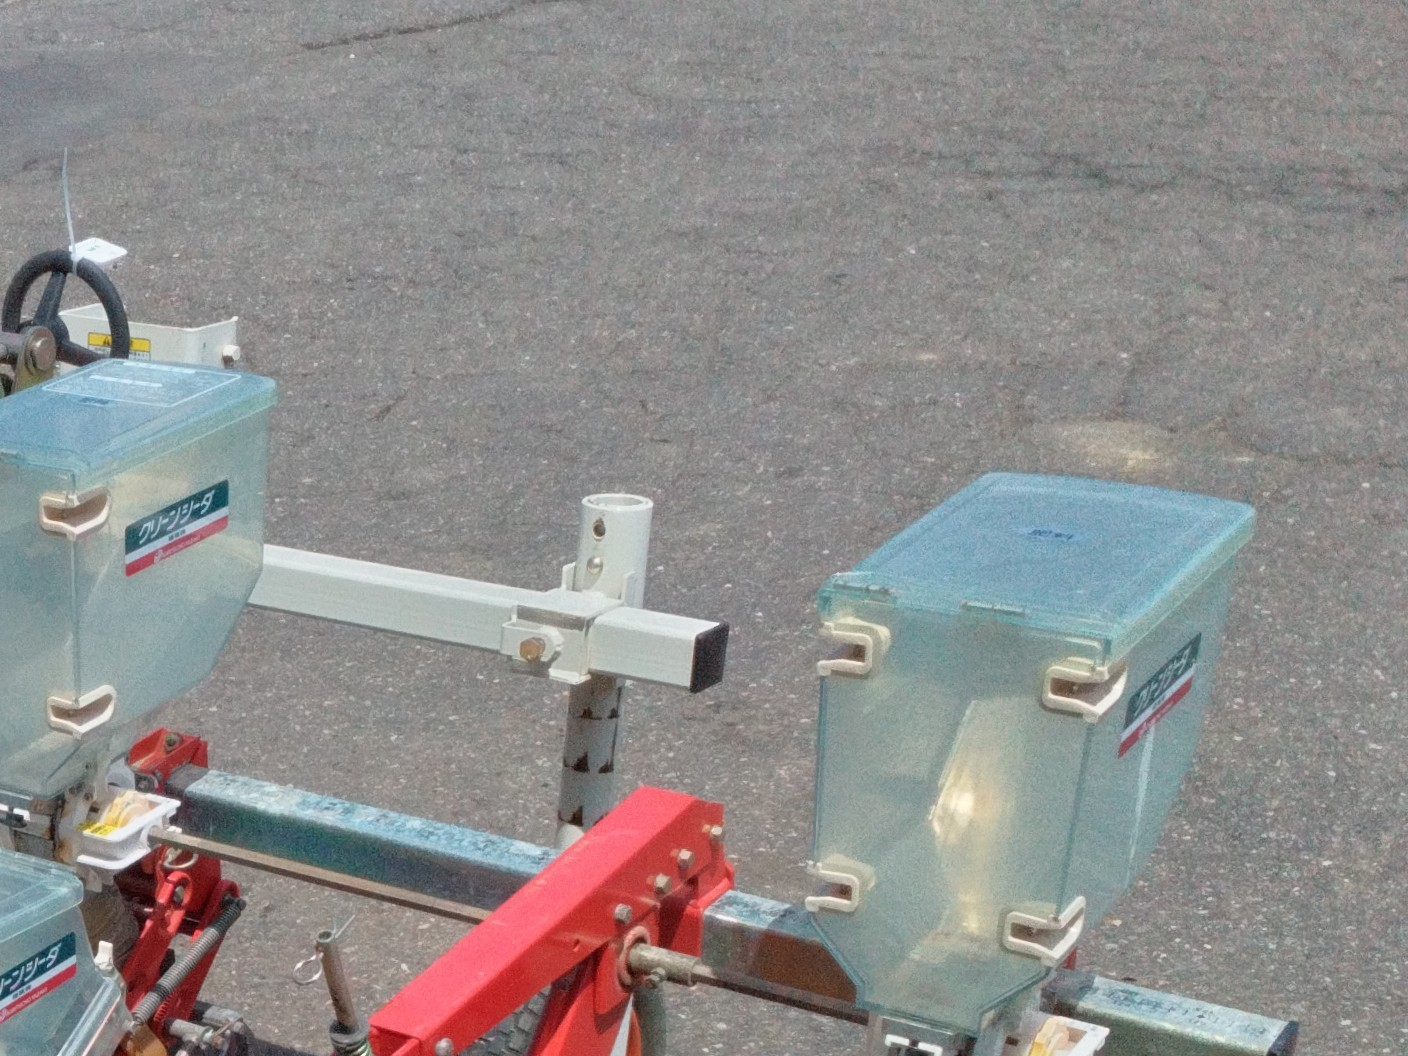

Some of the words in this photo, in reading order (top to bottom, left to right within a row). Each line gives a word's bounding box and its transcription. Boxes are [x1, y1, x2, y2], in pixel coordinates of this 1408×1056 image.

[139, 490, 215, 545] クリーンシーダ
